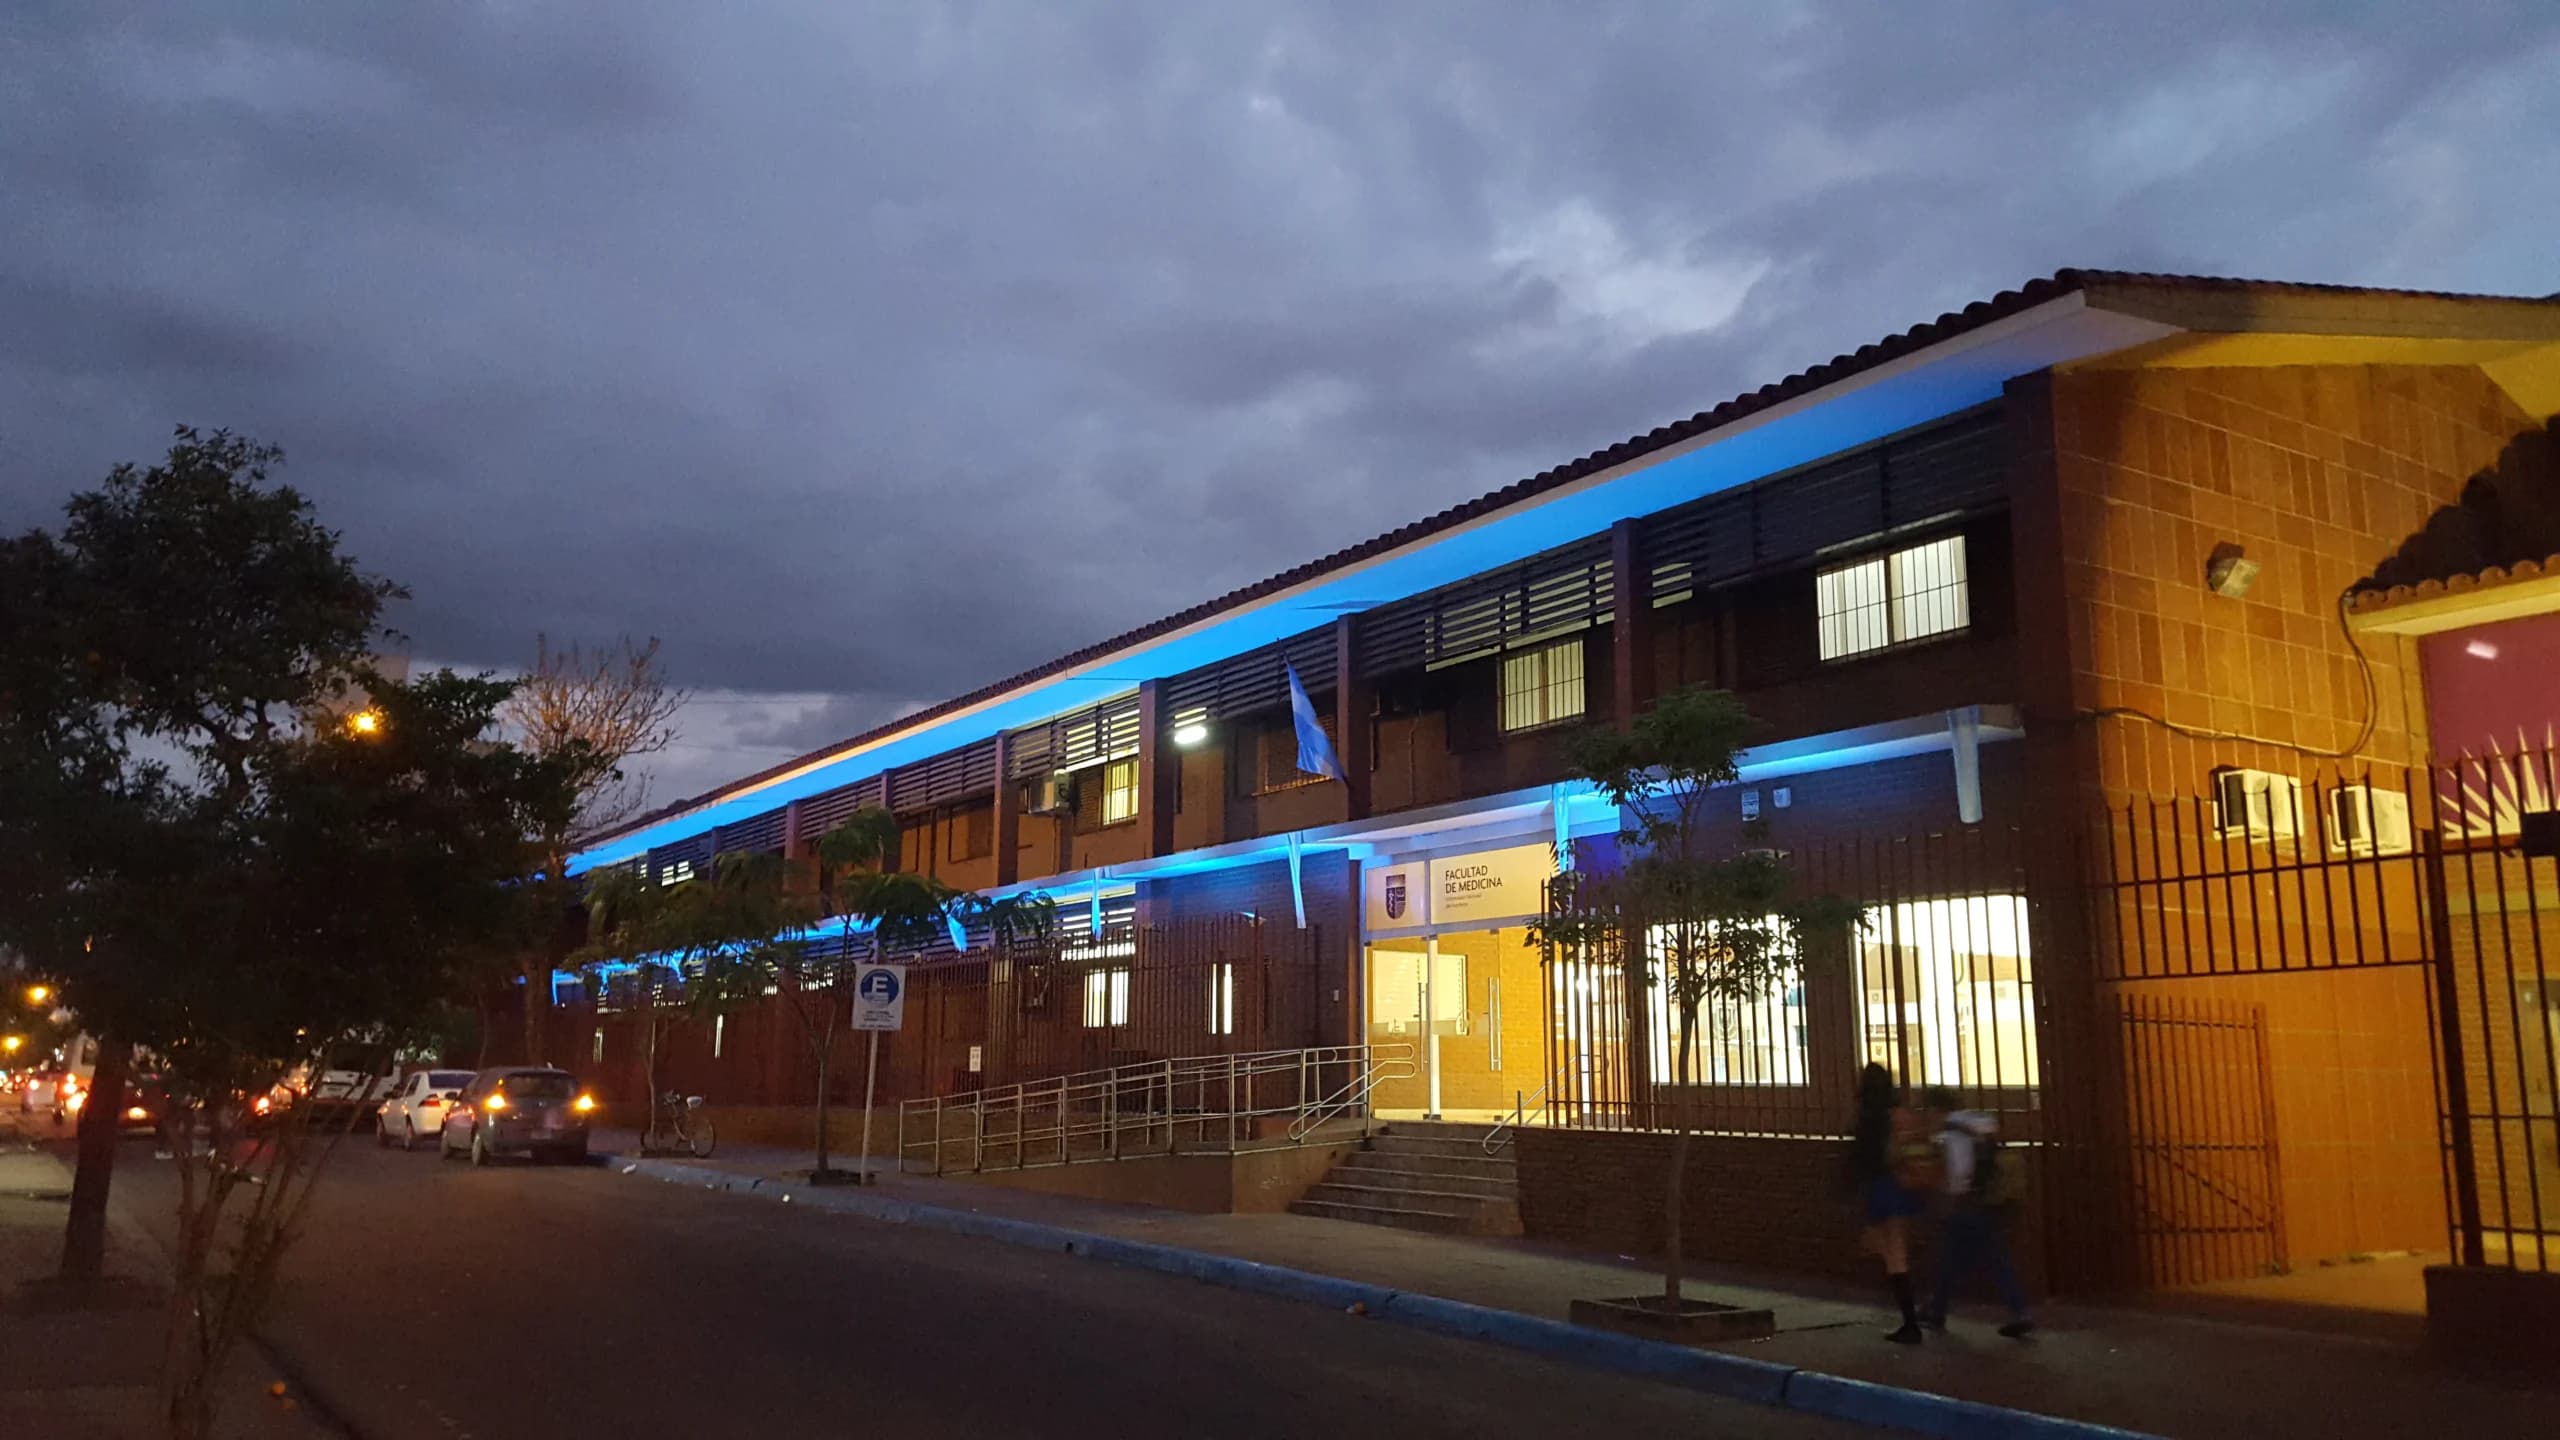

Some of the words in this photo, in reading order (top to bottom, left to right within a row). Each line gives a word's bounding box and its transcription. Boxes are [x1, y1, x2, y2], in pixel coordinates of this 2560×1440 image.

[1445, 865, 1488, 880] FACULTAD
[1445, 883, 1457, 894] DE
[1459, 877, 1503, 891] MEDICINA
[871, 976, 888, 995] E
